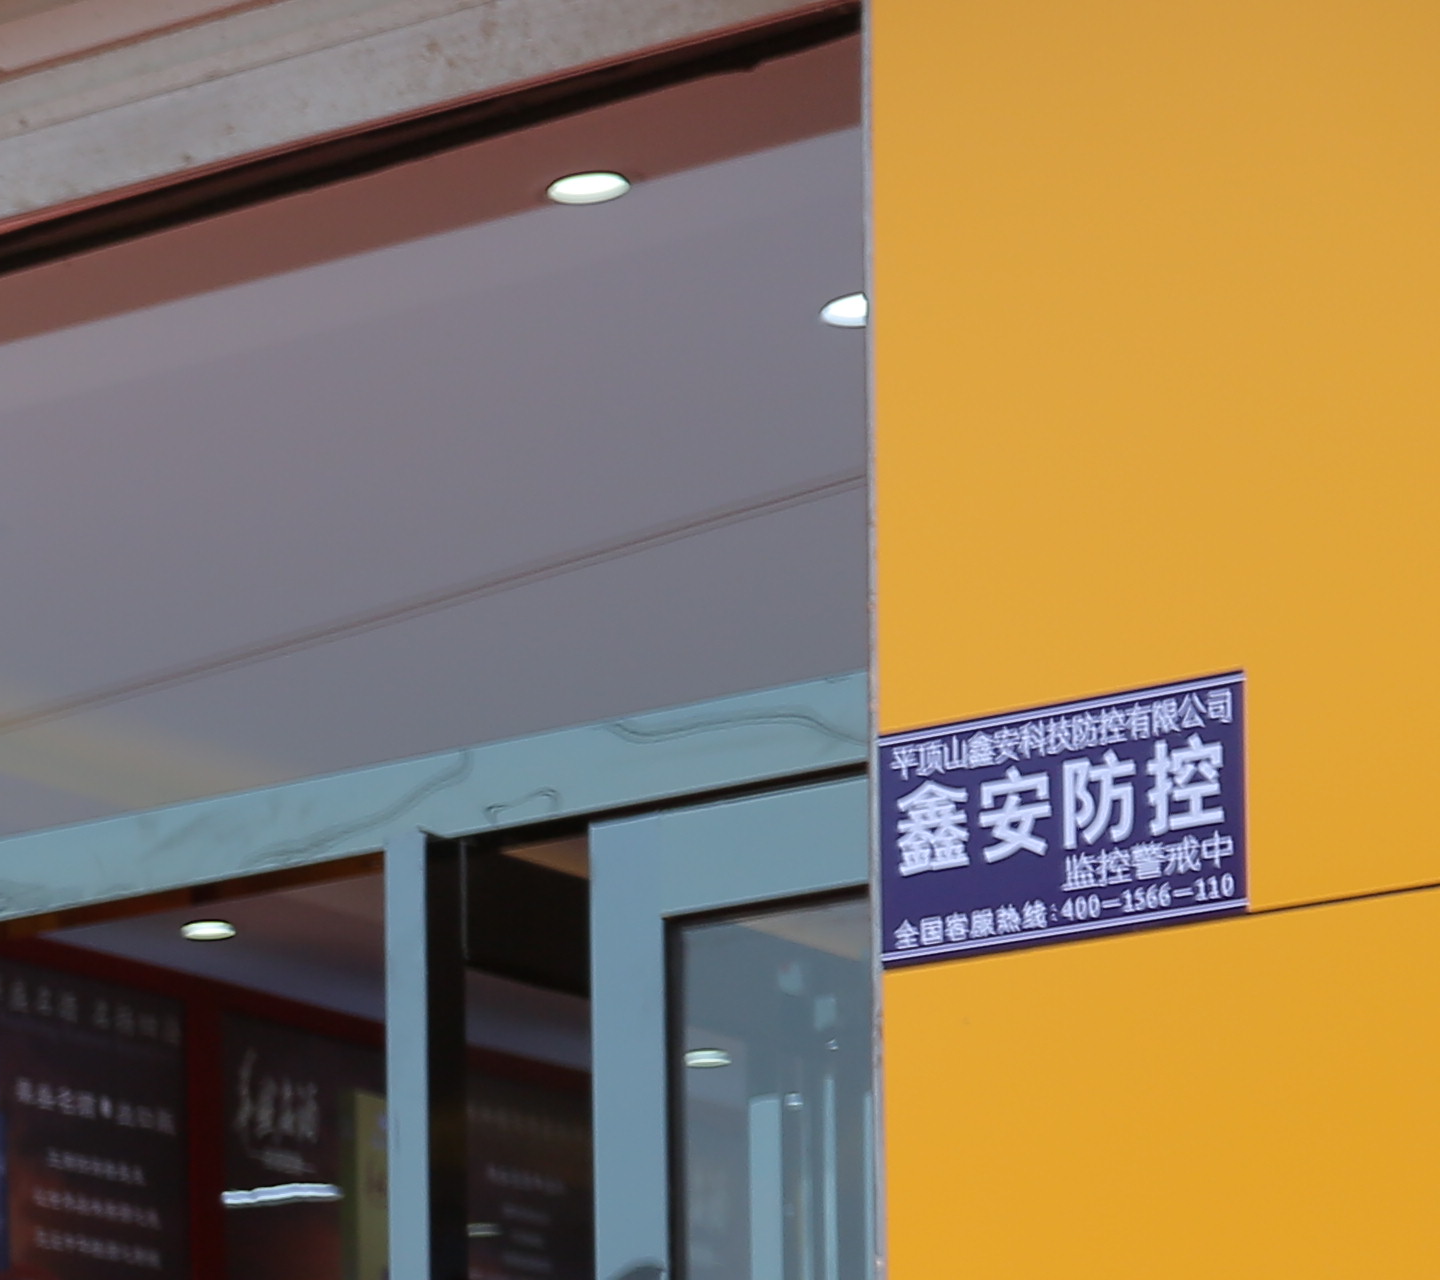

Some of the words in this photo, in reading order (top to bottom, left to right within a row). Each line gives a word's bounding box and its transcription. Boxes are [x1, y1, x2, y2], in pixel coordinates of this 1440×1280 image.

[890, 687, 1234, 780] 平顶山鑫安科技防控有限公司
[896, 735, 1225, 877] 鑫安防控
[1061, 830, 1234, 891] 监控警戒中
